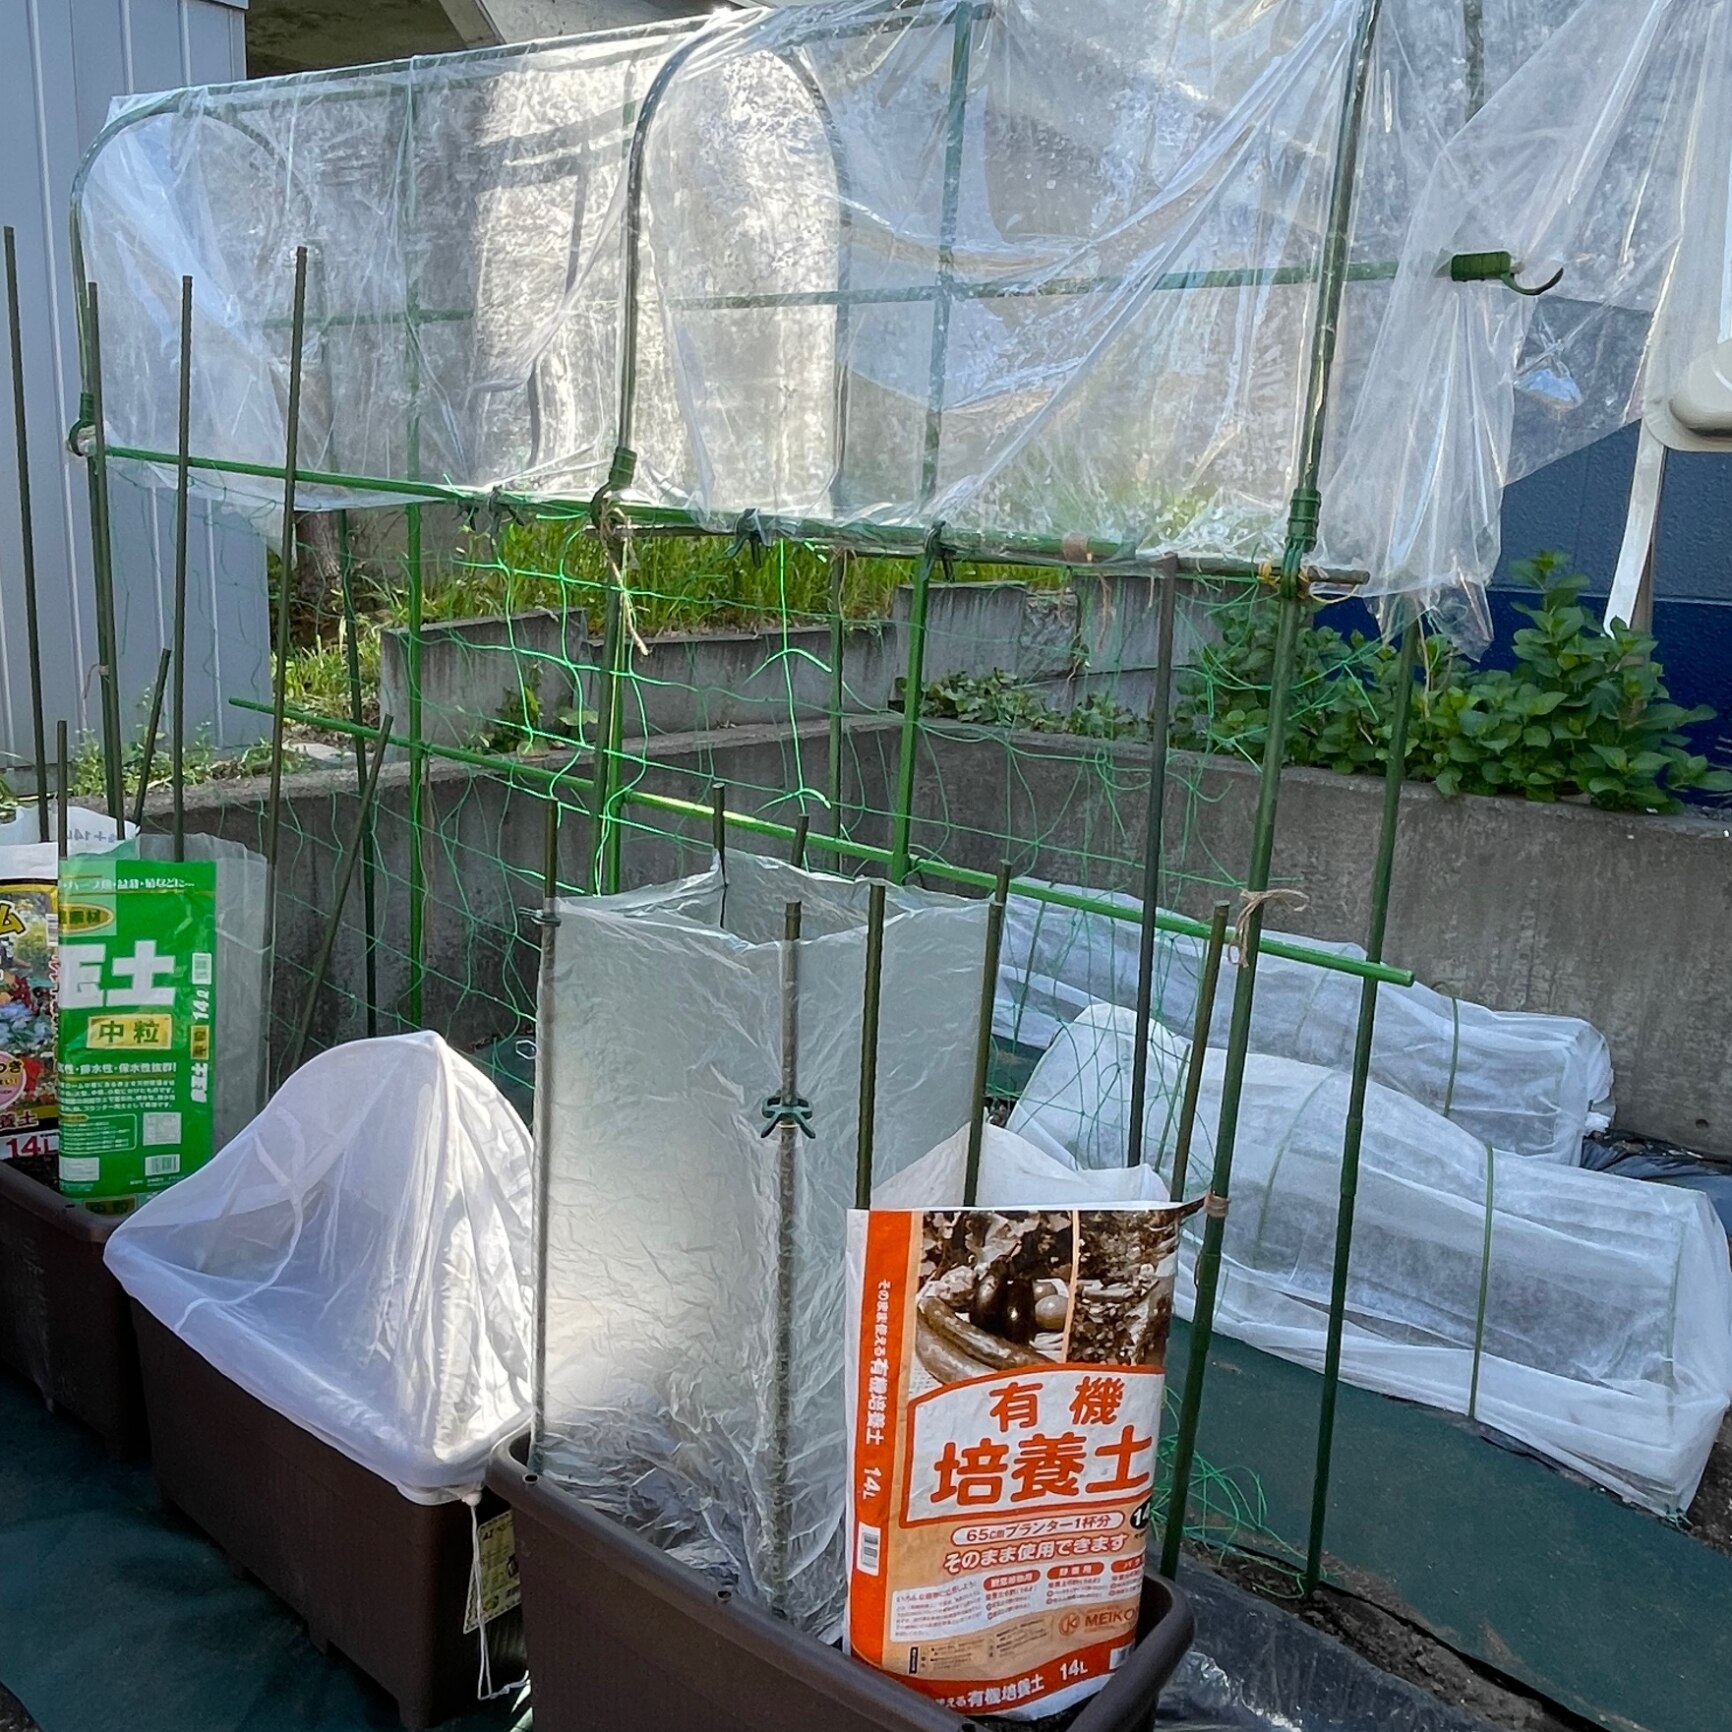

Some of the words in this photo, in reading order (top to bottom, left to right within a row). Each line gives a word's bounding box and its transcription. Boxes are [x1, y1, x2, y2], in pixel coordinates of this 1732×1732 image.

[99, 1020, 161, 1044] 中粒
[988, 1376, 1126, 1432] 有機
[930, 1424, 1152, 1506] 培養土
[944, 1532, 1129, 1574] そのまま使用できます
[1059, 1658, 1088, 1681] 14L
